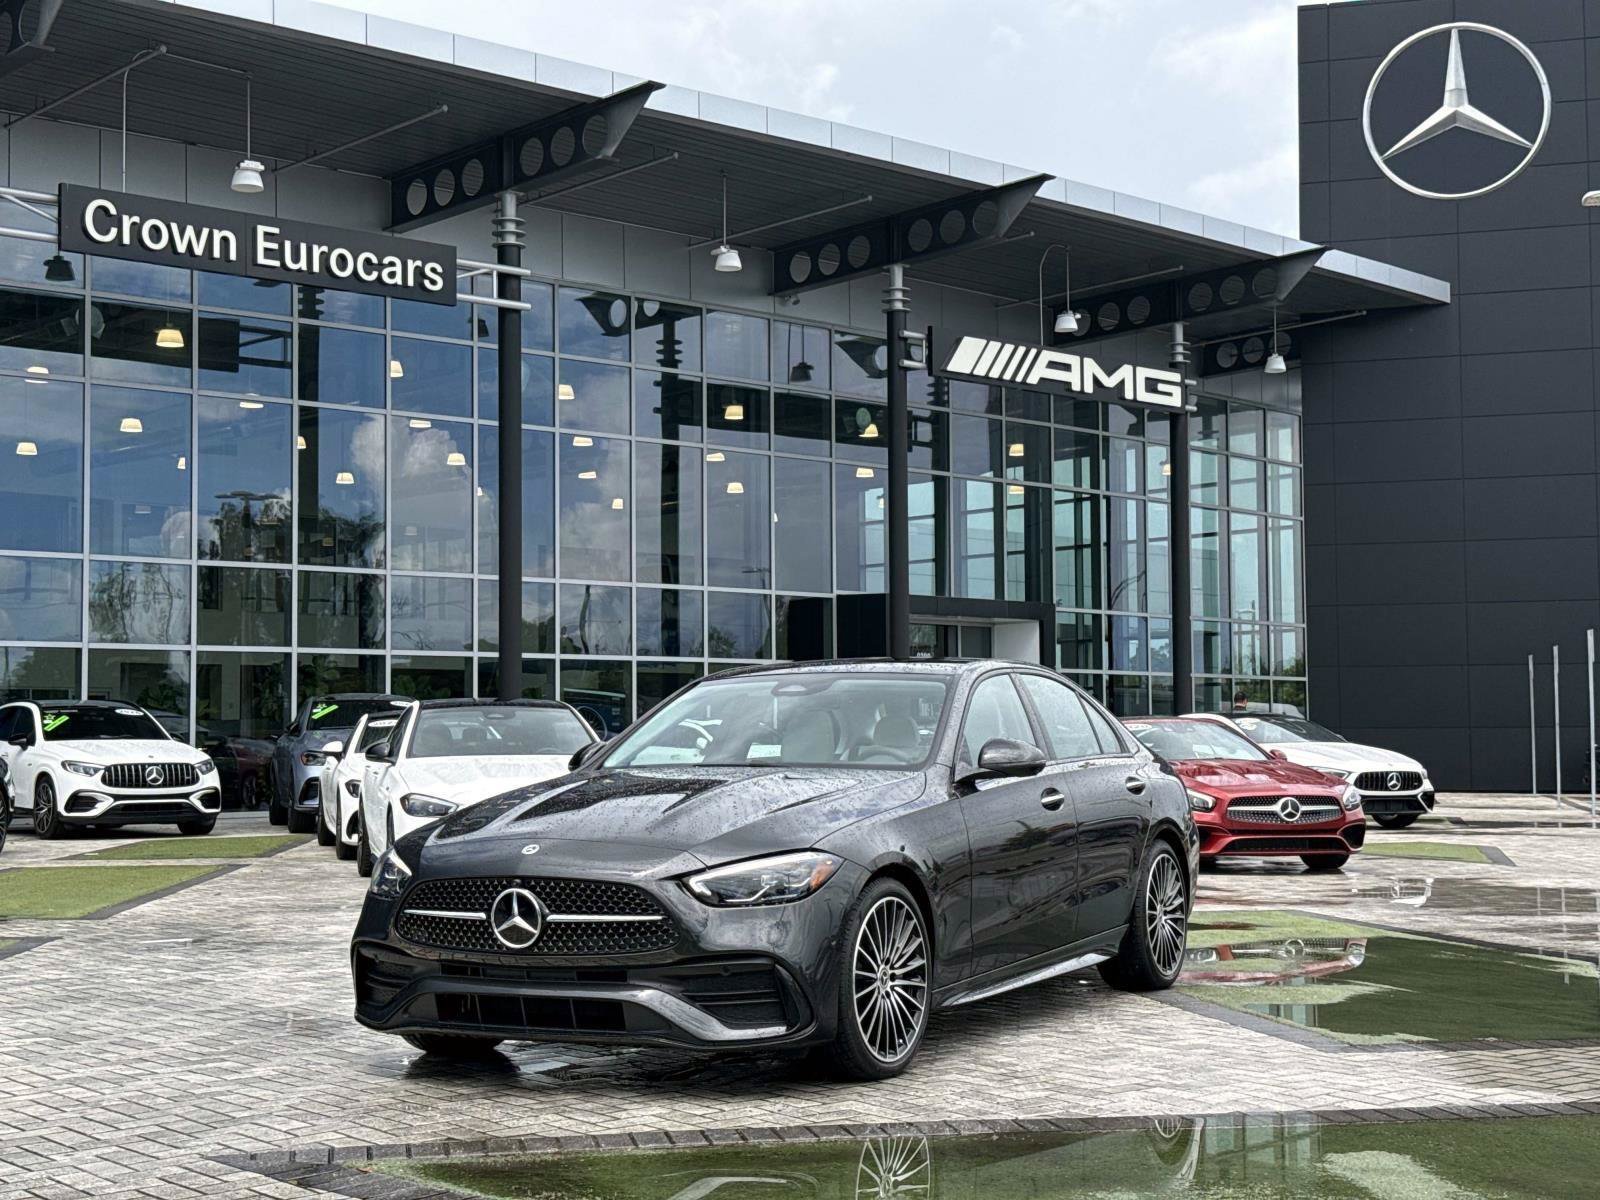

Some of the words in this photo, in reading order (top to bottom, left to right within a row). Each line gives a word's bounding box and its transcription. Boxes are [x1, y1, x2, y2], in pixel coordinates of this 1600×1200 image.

[84, 198, 237, 261] Crown
[255, 224, 444, 292] Eurocars
[1024, 349, 1182, 408] AMG
